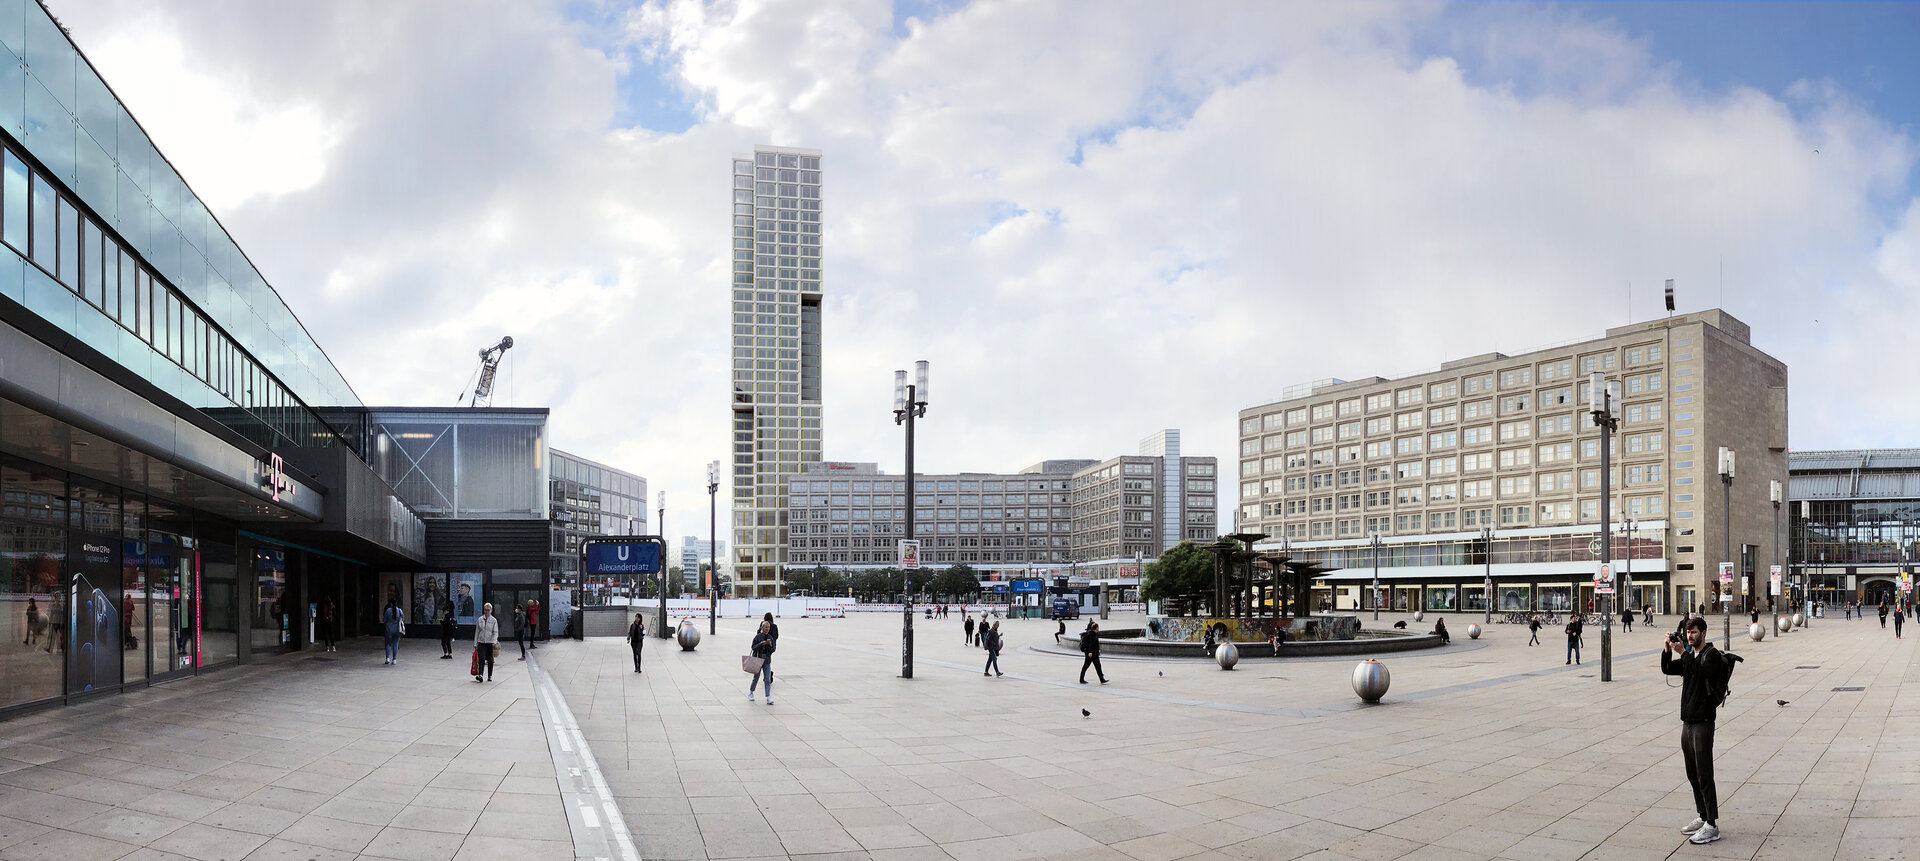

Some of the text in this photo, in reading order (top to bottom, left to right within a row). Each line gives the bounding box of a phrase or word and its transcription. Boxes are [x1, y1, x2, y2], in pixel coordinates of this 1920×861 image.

[271, 451, 282, 502] T
[86, 544, 100, 552] iPhone
[617, 545, 629, 560] U
[598, 563, 649, 572] Alexanderplatz
